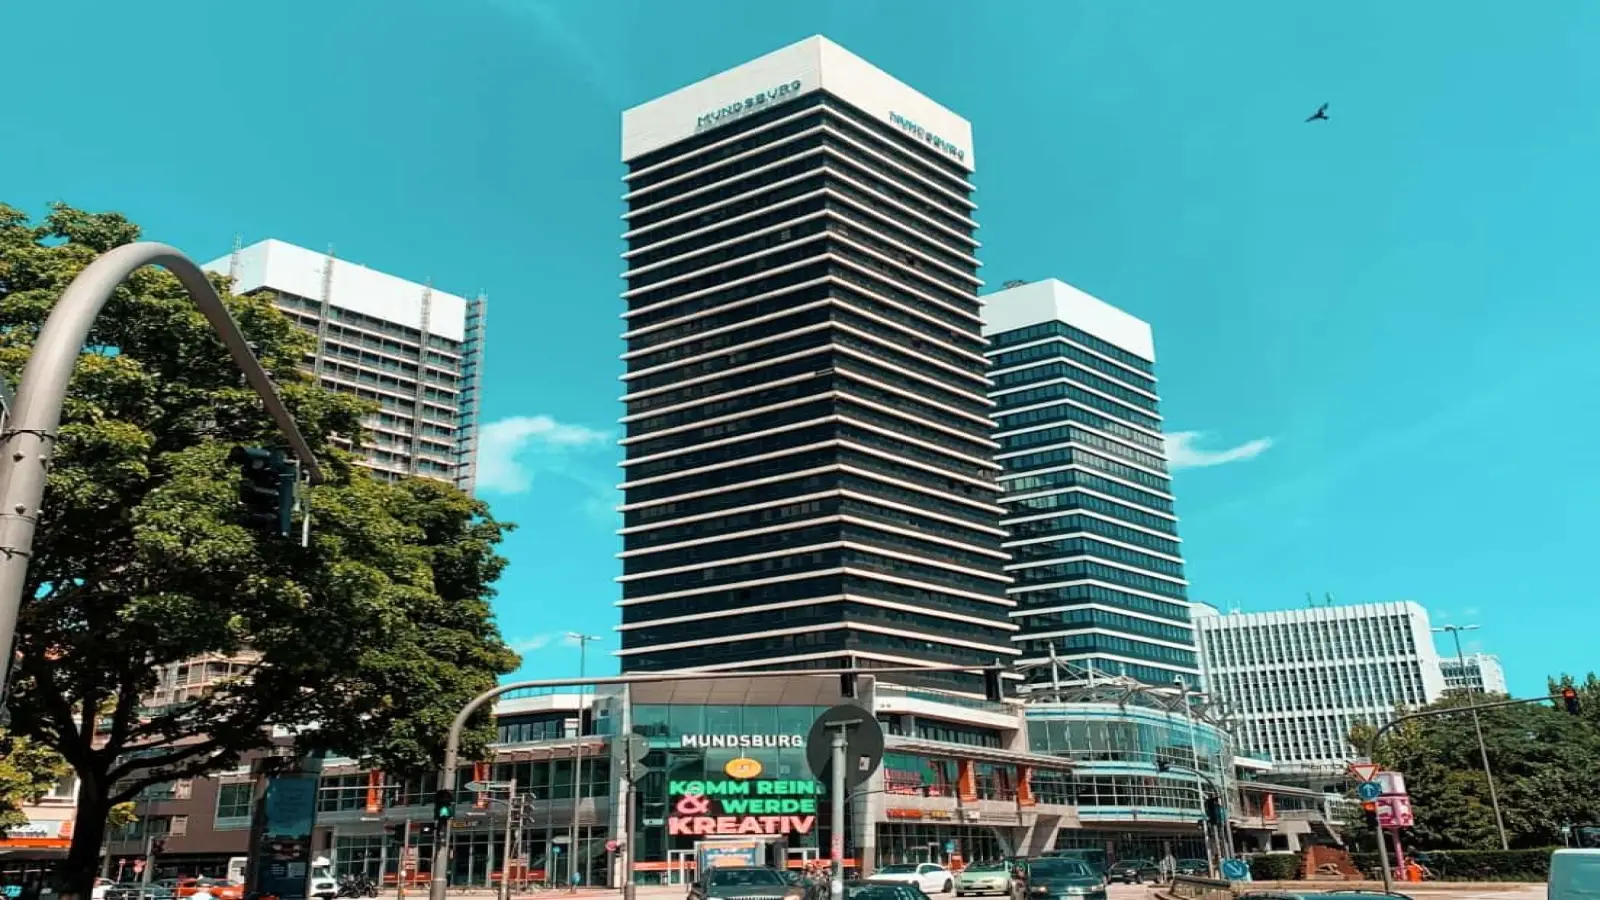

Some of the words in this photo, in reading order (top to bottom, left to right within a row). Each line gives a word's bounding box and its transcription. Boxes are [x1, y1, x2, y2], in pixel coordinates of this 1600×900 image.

[697, 80, 801, 127] MUNDSBURG
[681, 734, 804, 747] MUNDSBURG
[669, 780, 750, 795] KOMM
[756, 780, 815, 795] REIN
[676, 787, 710, 815] &
[720, 798, 817, 814] WERDE
[668, 815, 817, 835] KREATIV
